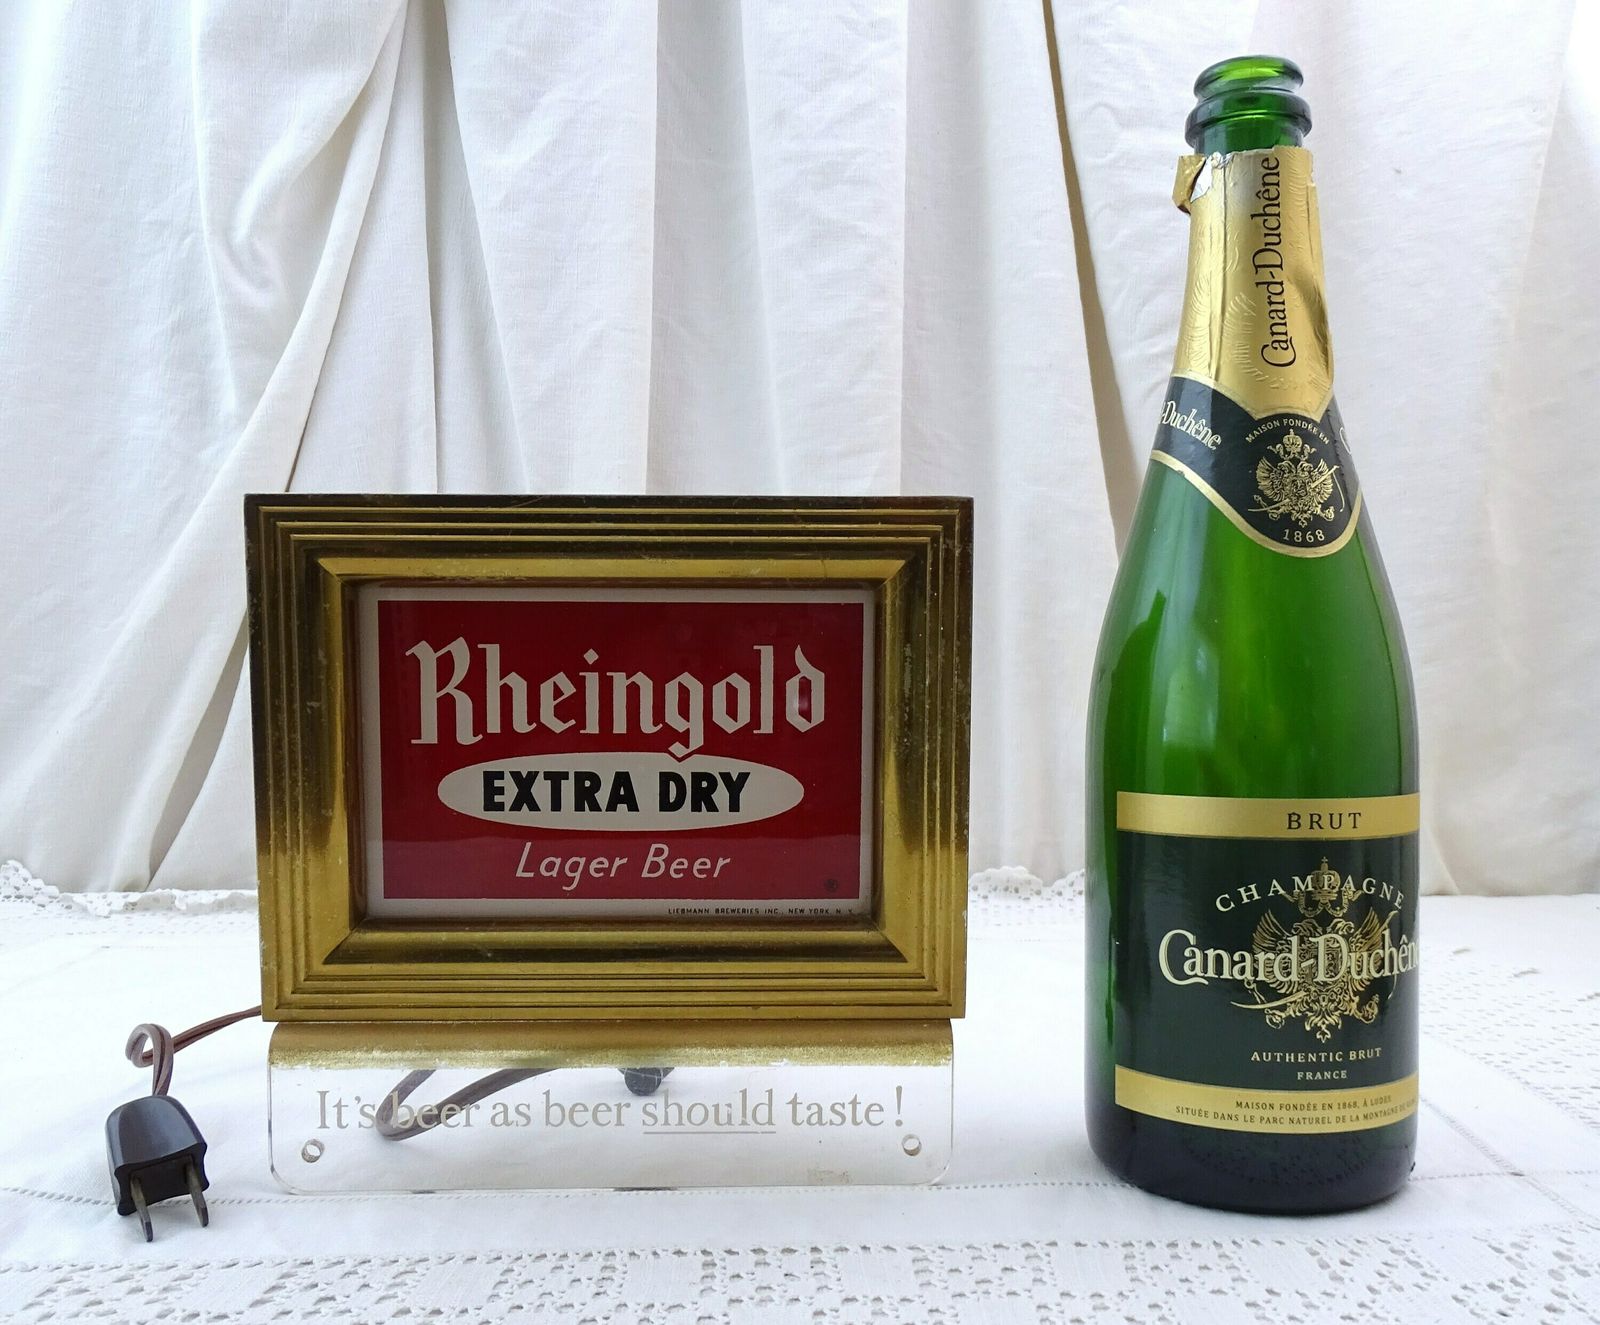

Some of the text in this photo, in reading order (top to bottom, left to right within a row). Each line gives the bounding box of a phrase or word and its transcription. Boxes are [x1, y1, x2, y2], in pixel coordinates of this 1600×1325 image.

[1250, 156, 1297, 368] Canard-Duchêne
[1245, 419, 1281, 443] MAISON
[1319, 432, 1330, 445] EN
[1283, 527, 1326, 543] 1868
[405, 636, 826, 758] Rheingold
[482, 770, 751, 814] EXTRA DRY
[1286, 811, 1363, 830] BRUT
[515, 841, 732, 891] Lager Beer
[1214, 873, 1405, 910] CHAMPAGNE
[668, 907, 710, 915] LIEBMANN
[714, 907, 760, 915] BREWERIES
[788, 907, 806, 915] NEW
[1158, 927, 1419, 986] Canard-Duchên
[1250, 1047, 1382, 1063] AUTHENTIC BRUT
[1297, 1069, 1348, 1081] FRANCE
[316, 1089, 377, 1130] It's
[390, 1090, 481, 1129] beer
[489, 1101, 532, 1128] as
[542, 1089, 632, 1128] beer
[641, 1087, 775, 1129] should
[1175, 1105, 1210, 1119] SITUÉE
[1213, 1111, 1239, 1122] DANS
[1243, 1114, 1256, 1124] LE
[1259, 1115, 1285, 1125] PARC
[1288, 1115, 1332, 1125] NATUREL
[1335, 1114, 1347, 1124] DE
[1349, 1113, 1360, 1122] LA
[1362, 1104, 1399, 1121] MONTAGNE
[1235, 1100, 1275, 1111] MAISON
[1279, 1101, 1318, 1112] FONDÉE
[1321, 1102, 1334, 1111] EN
[1370, 1094, 1392, 1107] LUDES
